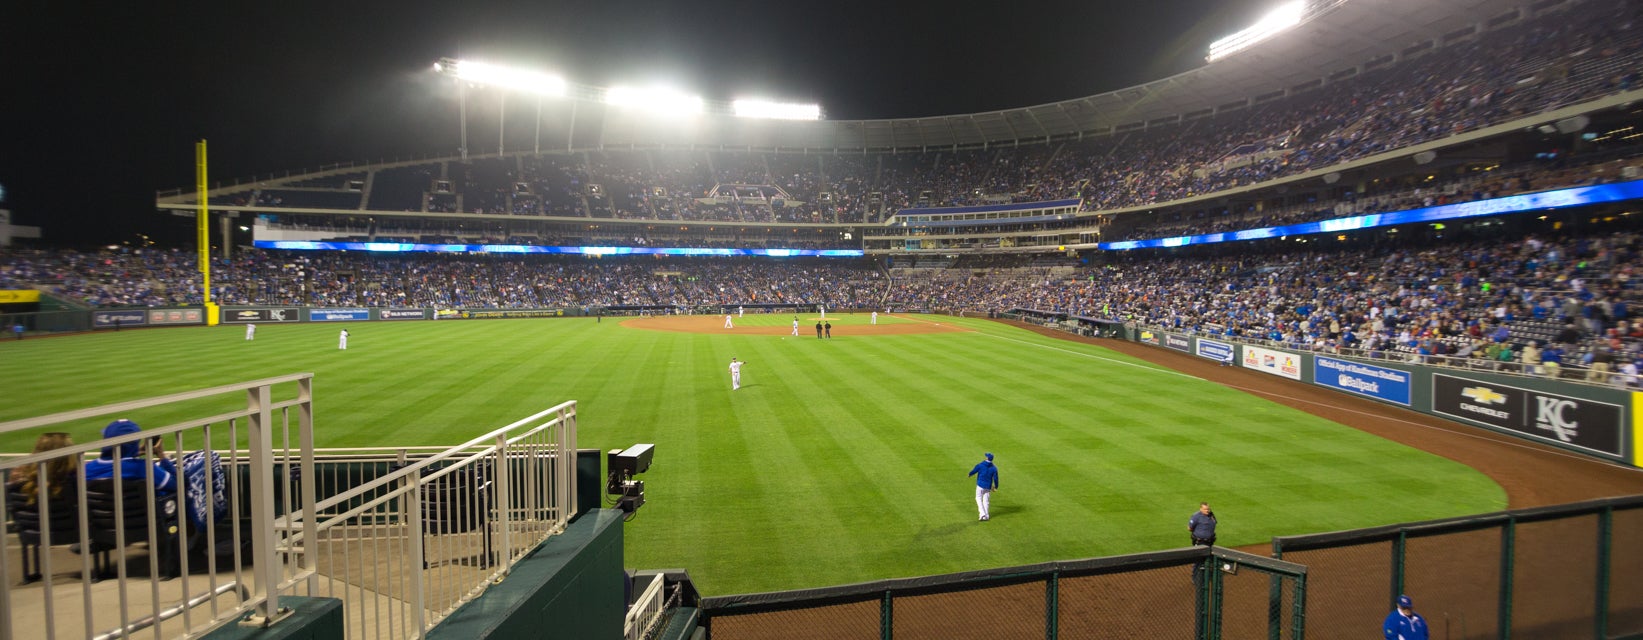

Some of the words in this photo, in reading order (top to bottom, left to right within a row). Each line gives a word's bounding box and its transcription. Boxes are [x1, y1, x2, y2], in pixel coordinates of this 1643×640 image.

[1318, 359, 1335, 370] Official
[1336, 363, 1346, 373] App
[1379, 371, 1405, 383] Stadium
[1347, 376, 1379, 393] Ballpark
[1460, 402, 1510, 420] CHEVROLET
[1536, 396, 1578, 442] KC
